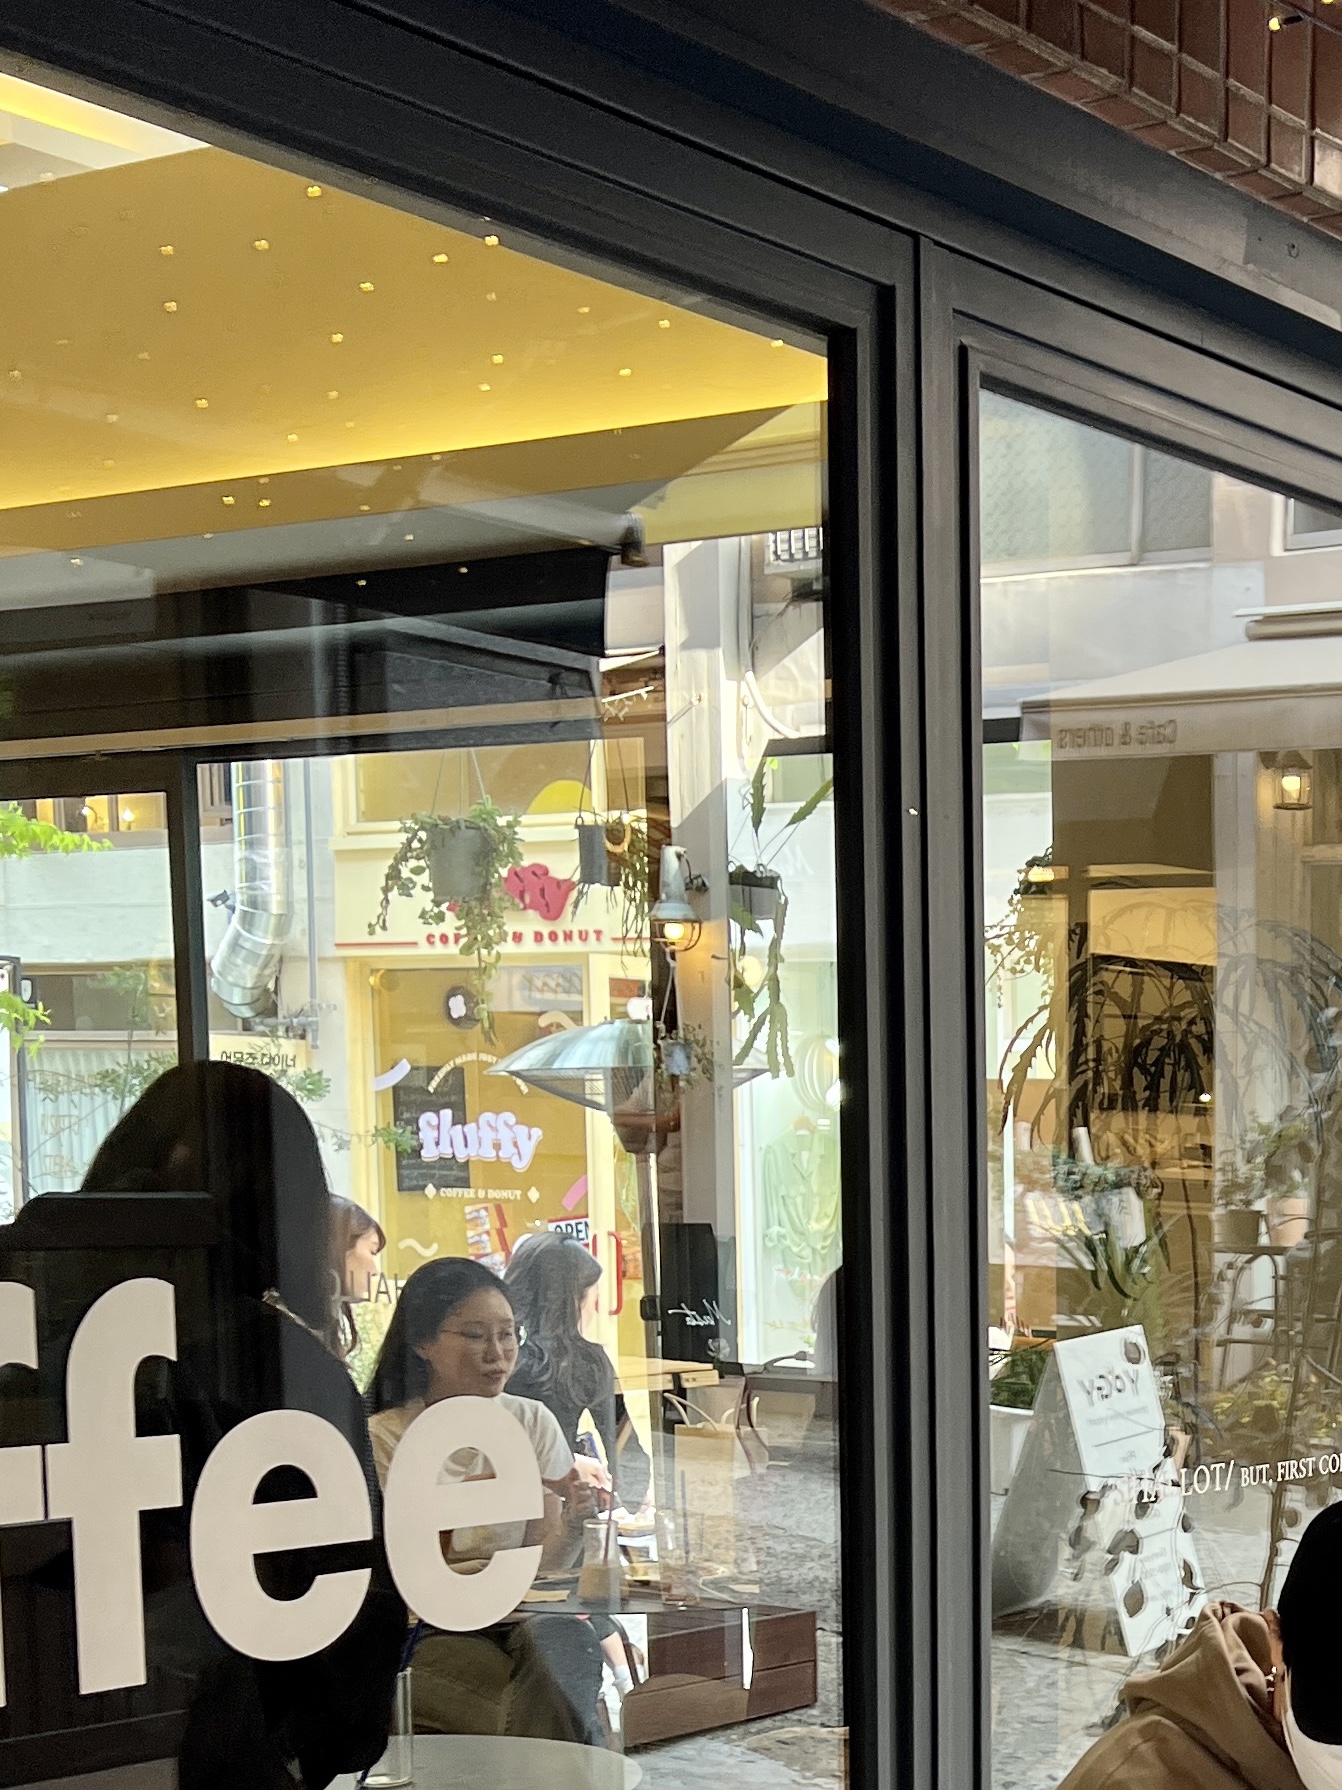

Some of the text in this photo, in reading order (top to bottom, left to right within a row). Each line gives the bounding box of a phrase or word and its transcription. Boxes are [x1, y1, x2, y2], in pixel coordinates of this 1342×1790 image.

[534, 930, 603, 943] DONUT
[418, 1107, 543, 1172] fluffy
[440, 1187, 476, 1199] COFFEE
[487, 1188, 522, 1200] DONUT
[1241, 1463, 1273, 1489] BUT,
[1276, 1457, 1317, 1483] FIRST
